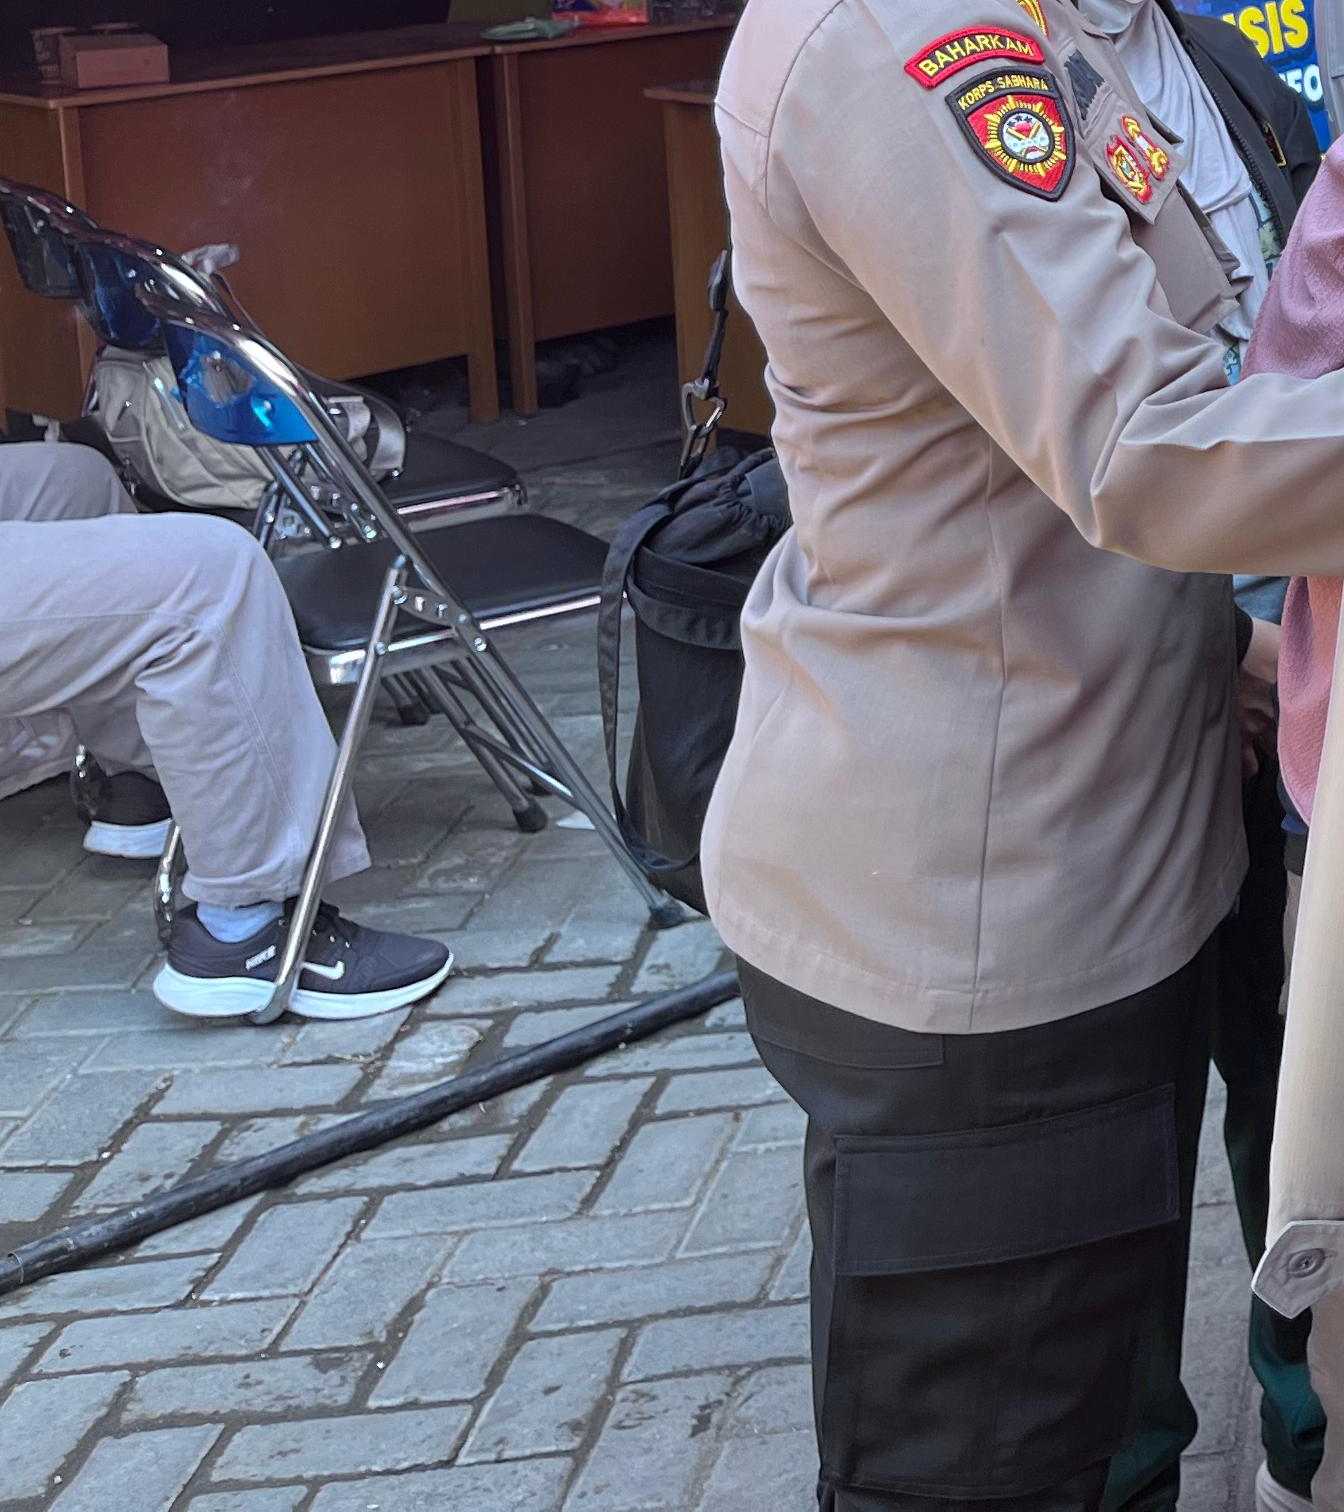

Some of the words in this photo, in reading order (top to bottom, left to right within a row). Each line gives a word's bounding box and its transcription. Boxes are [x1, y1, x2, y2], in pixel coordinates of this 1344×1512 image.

[918, 34, 1034, 76] BAHARKAM
[957, 80, 995, 111] KORPS
[997, 74, 1048, 90] SABHARA
[1278, 63, 1324, 103] FO
